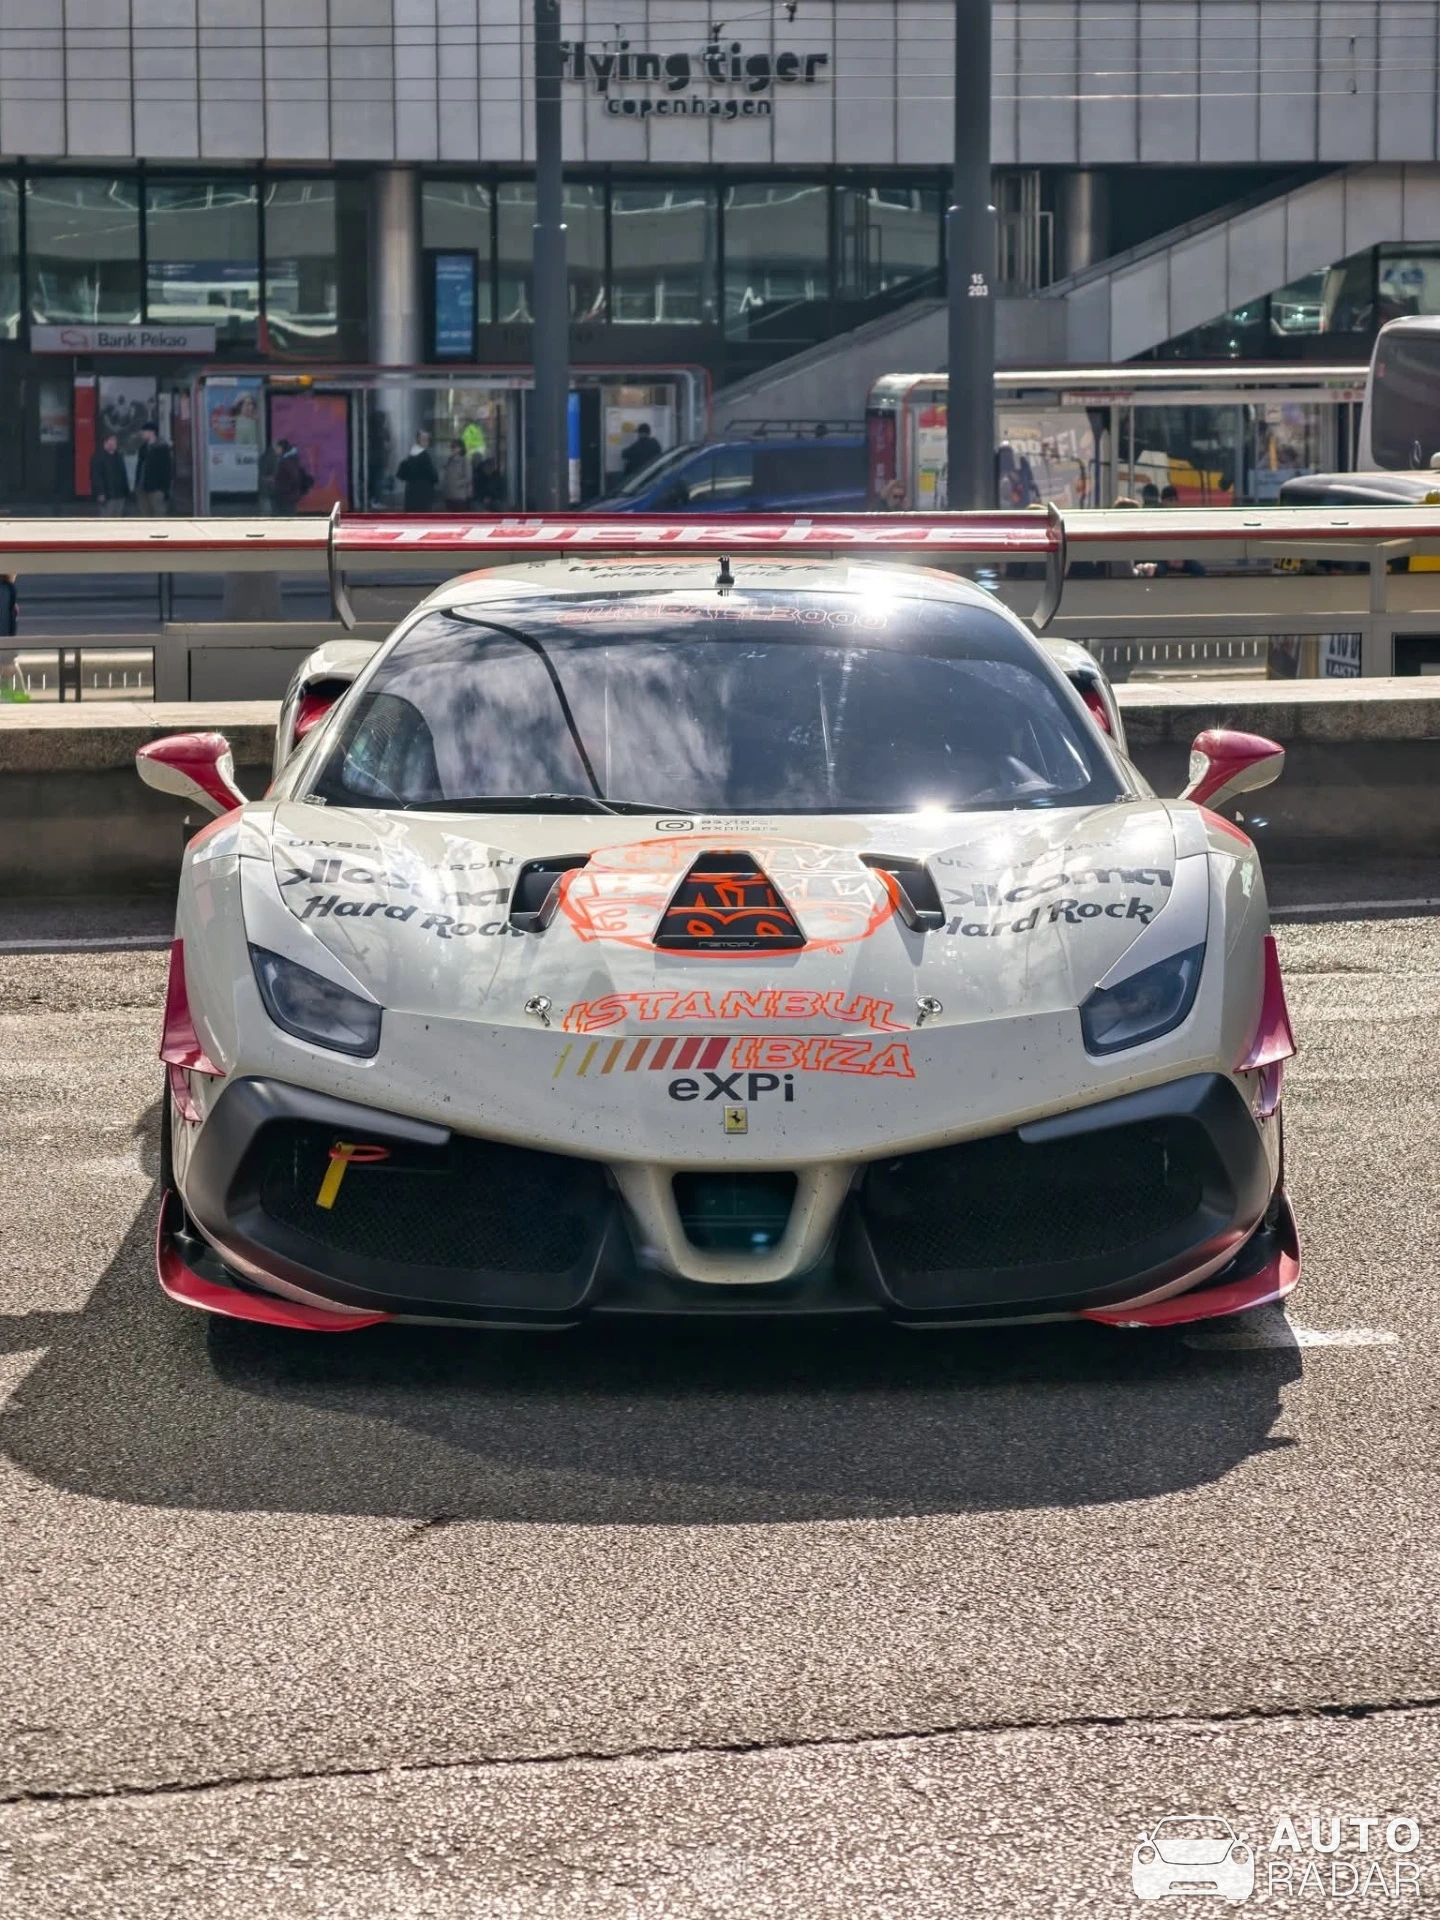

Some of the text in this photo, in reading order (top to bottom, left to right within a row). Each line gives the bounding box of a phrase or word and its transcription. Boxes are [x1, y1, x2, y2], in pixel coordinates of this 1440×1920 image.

[703, 42, 829, 92] tiger
[607, 96, 771, 119] copenhagen
[968, 285, 988, 296] 203
[971, 273, 984, 284] 15
[98, 332, 187, 347] Bank Pekao
[302, 896, 418, 921] Hard
[1047, 897, 1153, 925] Rock
[563, 990, 911, 1032] ISTANBUL
[731, 1037, 916, 1078] IBIZA
[668, 1072, 795, 1102] eXPi
